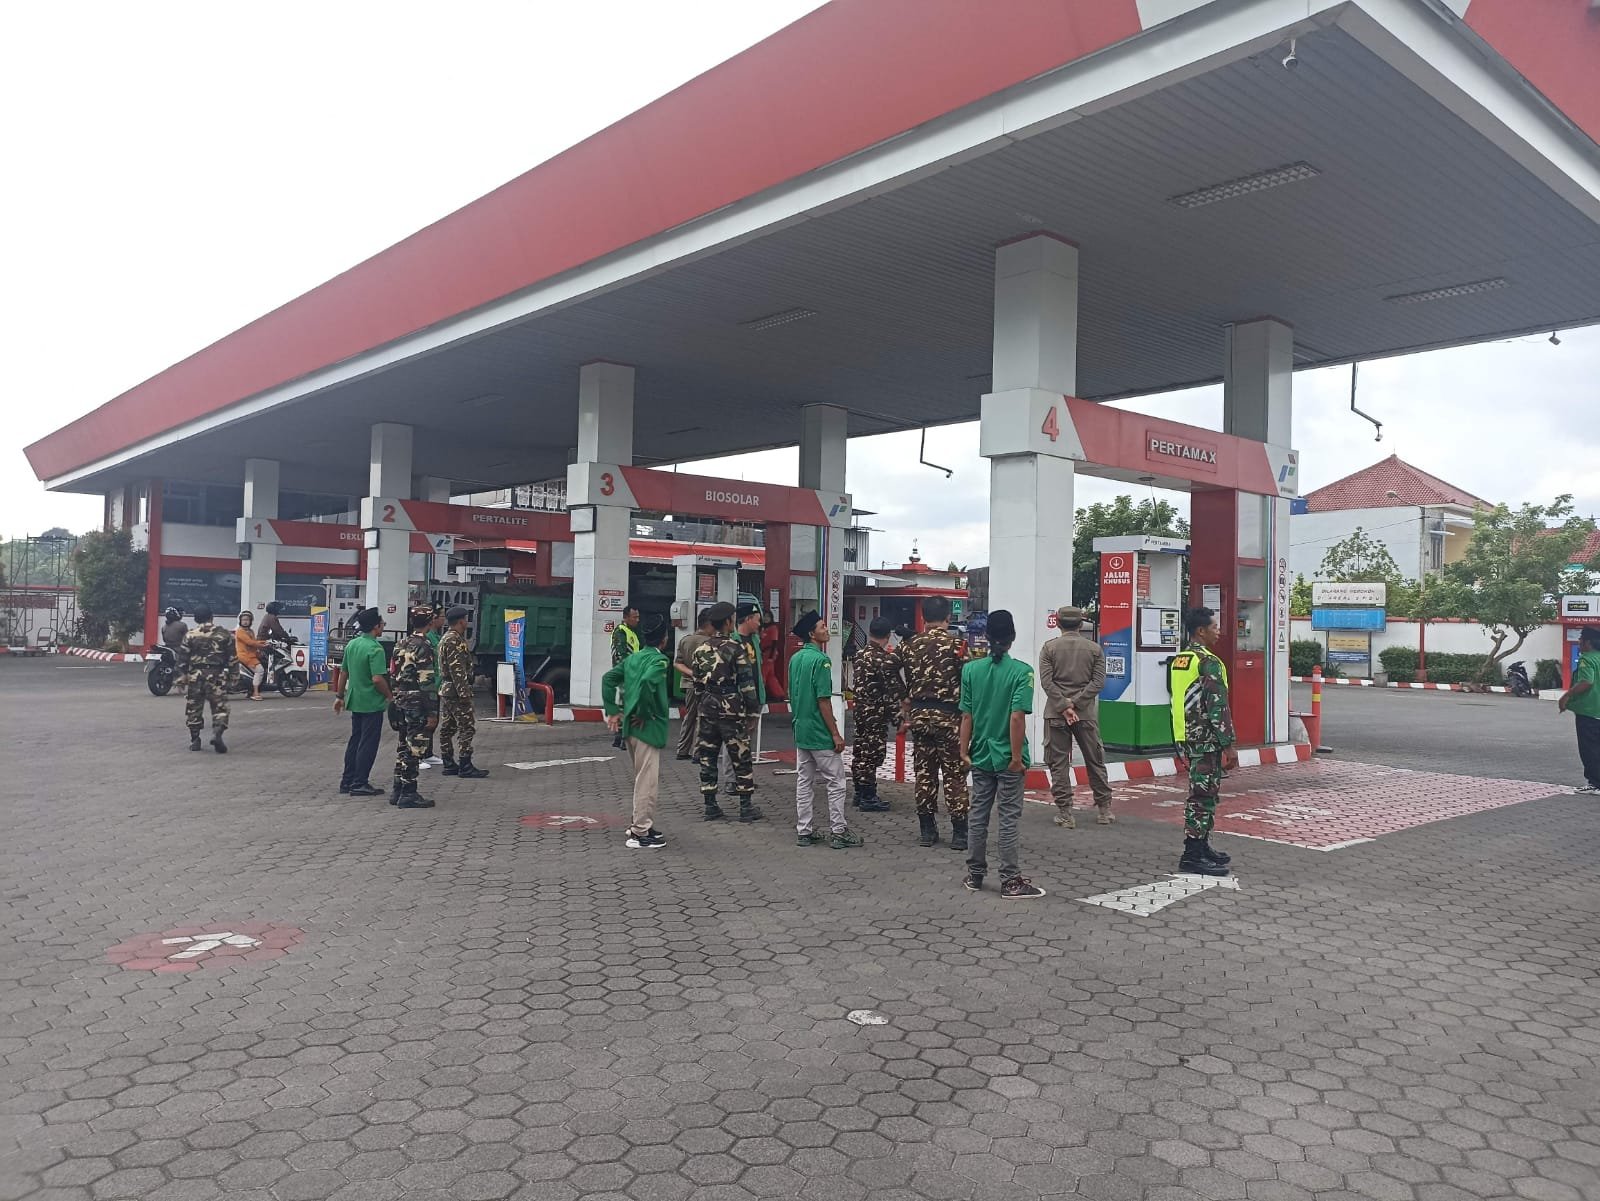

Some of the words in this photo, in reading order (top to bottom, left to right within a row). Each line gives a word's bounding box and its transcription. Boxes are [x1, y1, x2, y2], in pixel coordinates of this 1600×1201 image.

[1041, 406, 1060, 441] 4
[1151, 438, 1217, 464] PERTAMAX
[600, 472, 615, 496] 3
[705, 490, 760, 506] BIOSOLAR
[382, 504, 396, 523] 2
[472, 514, 529, 526] PERTALITE
[254, 523, 262, 538] 1
[1104, 571, 1130, 579] JALUR
[1048, 616, 1057, 626] 35
